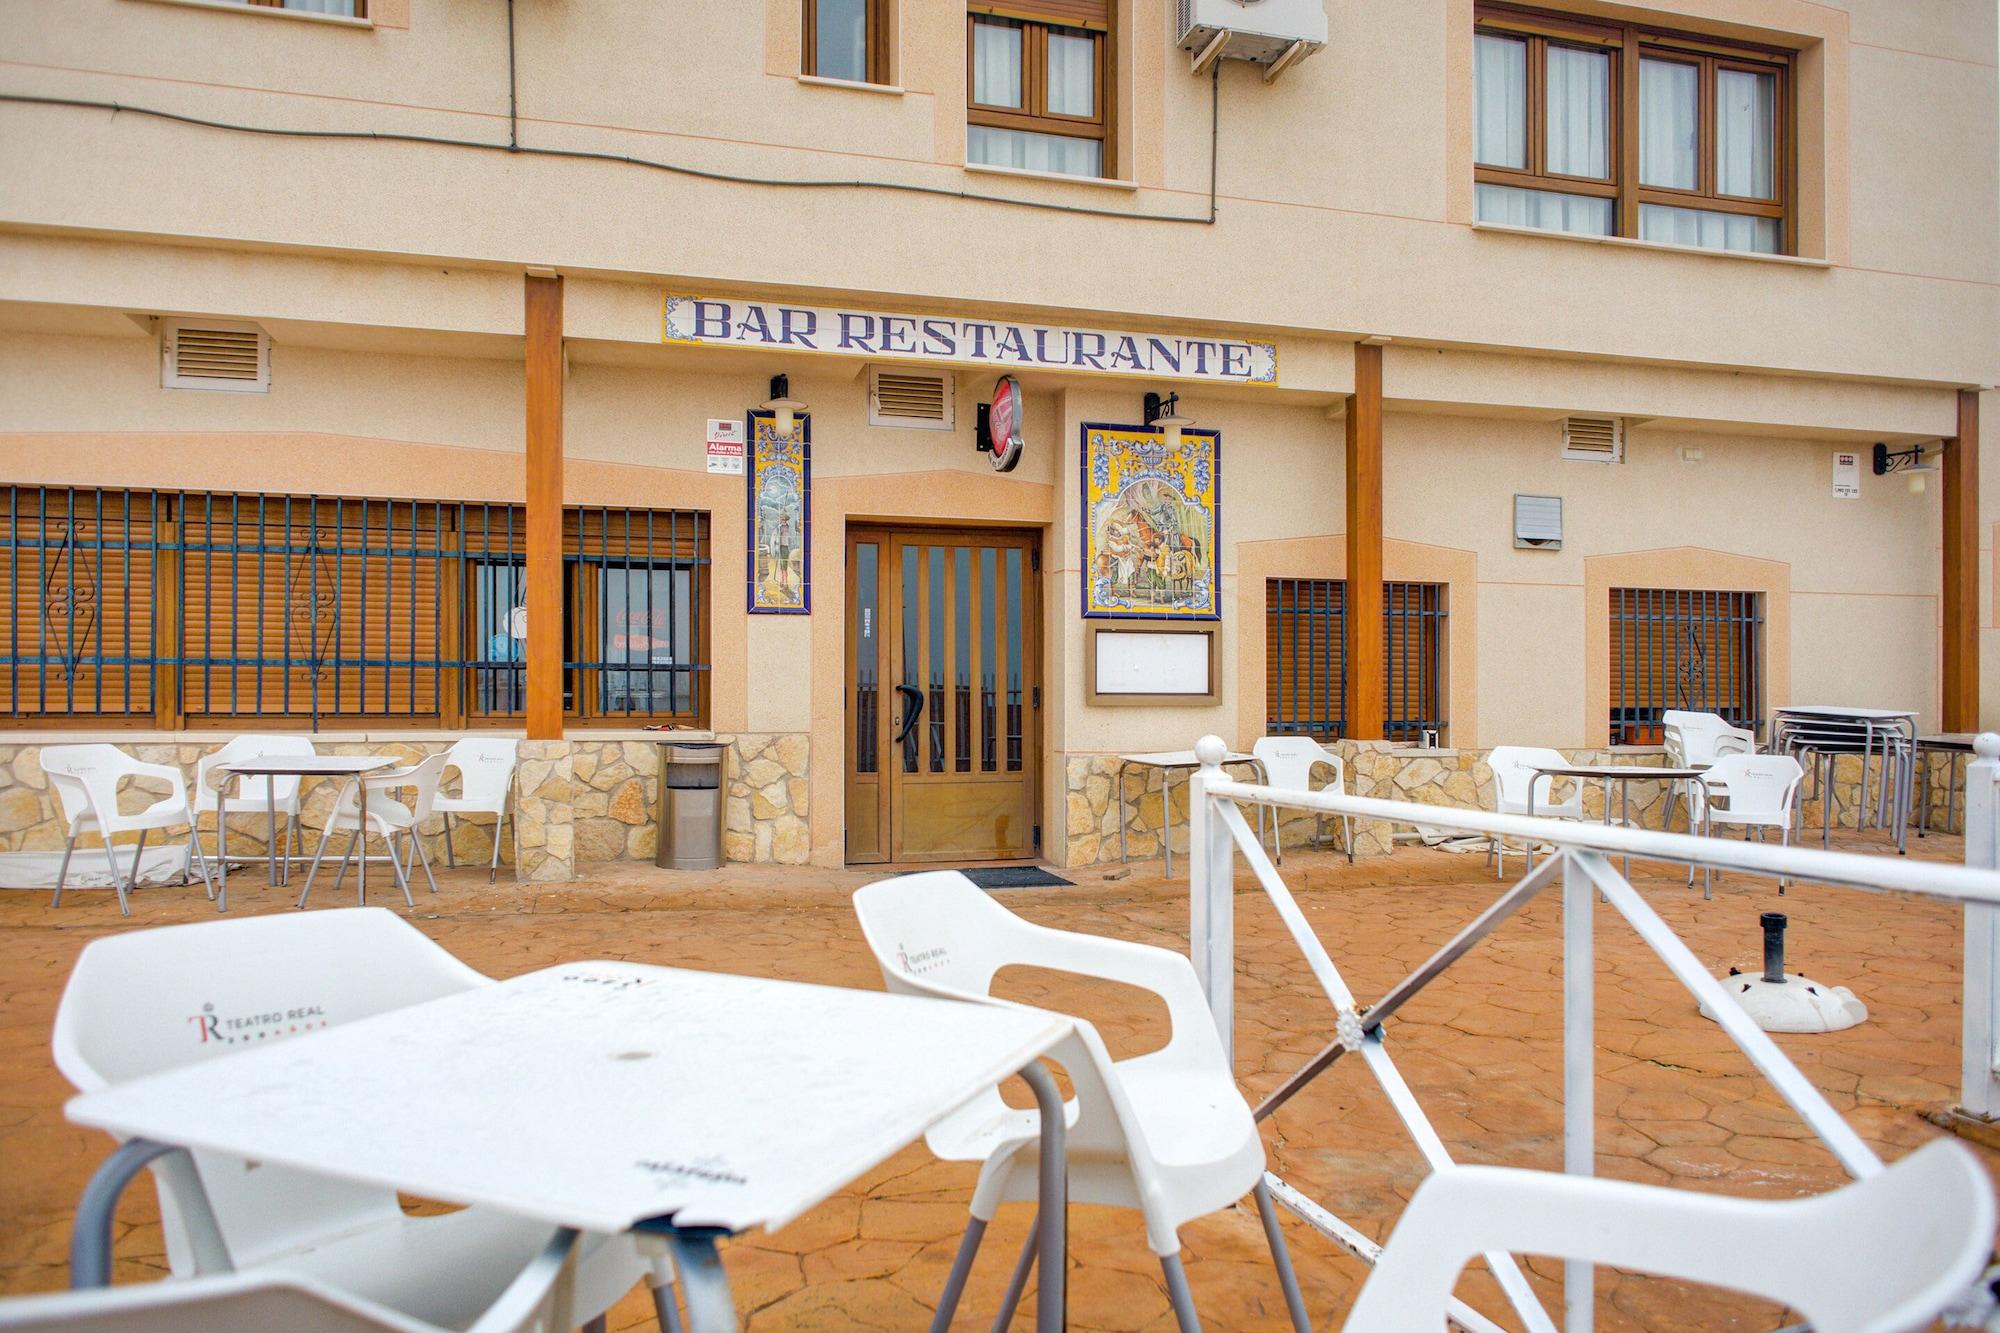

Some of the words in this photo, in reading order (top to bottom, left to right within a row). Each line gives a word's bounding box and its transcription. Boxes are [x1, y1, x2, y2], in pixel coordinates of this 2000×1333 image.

[693, 301, 818, 349] BAR
[837, 313, 1252, 377] RESTAURANTE
[709, 442, 742, 452] Alarma
[226, 1012, 282, 1030] TEATRO
[287, 1005, 325, 1021] REAL
